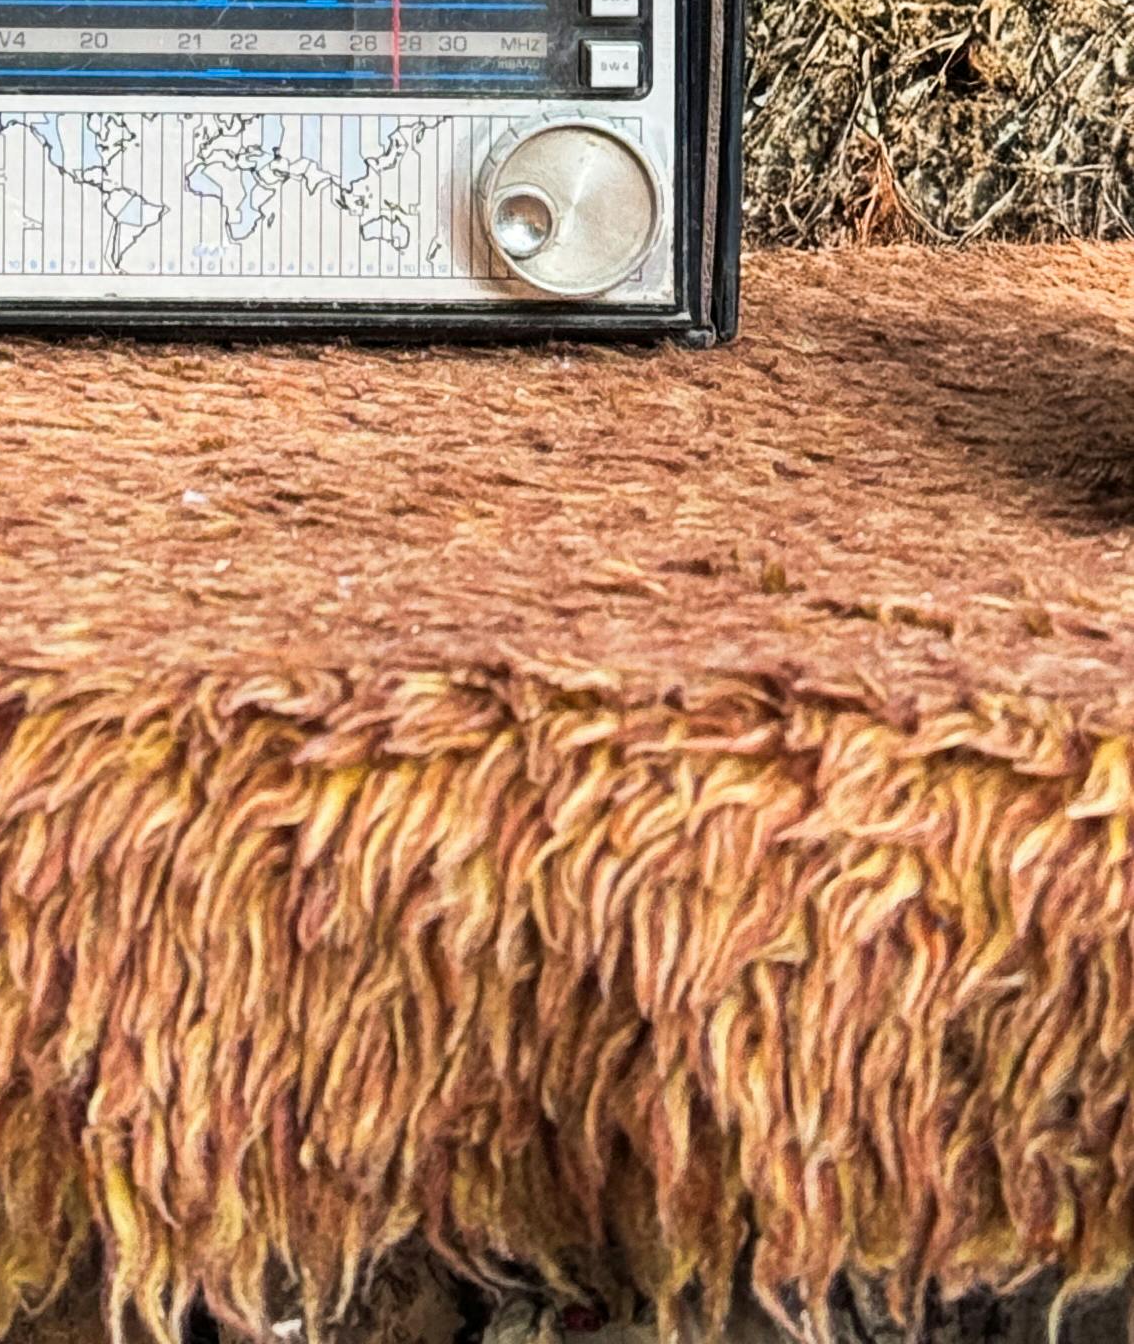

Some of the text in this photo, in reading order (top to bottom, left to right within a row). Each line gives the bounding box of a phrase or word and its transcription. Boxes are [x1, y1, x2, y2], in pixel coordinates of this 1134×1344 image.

[80, 32, 109, 48] 20
[177, 33, 202, 49] 21
[229, 33, 258, 50] 22
[298, 34, 326, 50] 24
[349, 34, 377, 51] 26
[438, 35, 467, 51] 30
[501, 36, 540, 51] MHz
